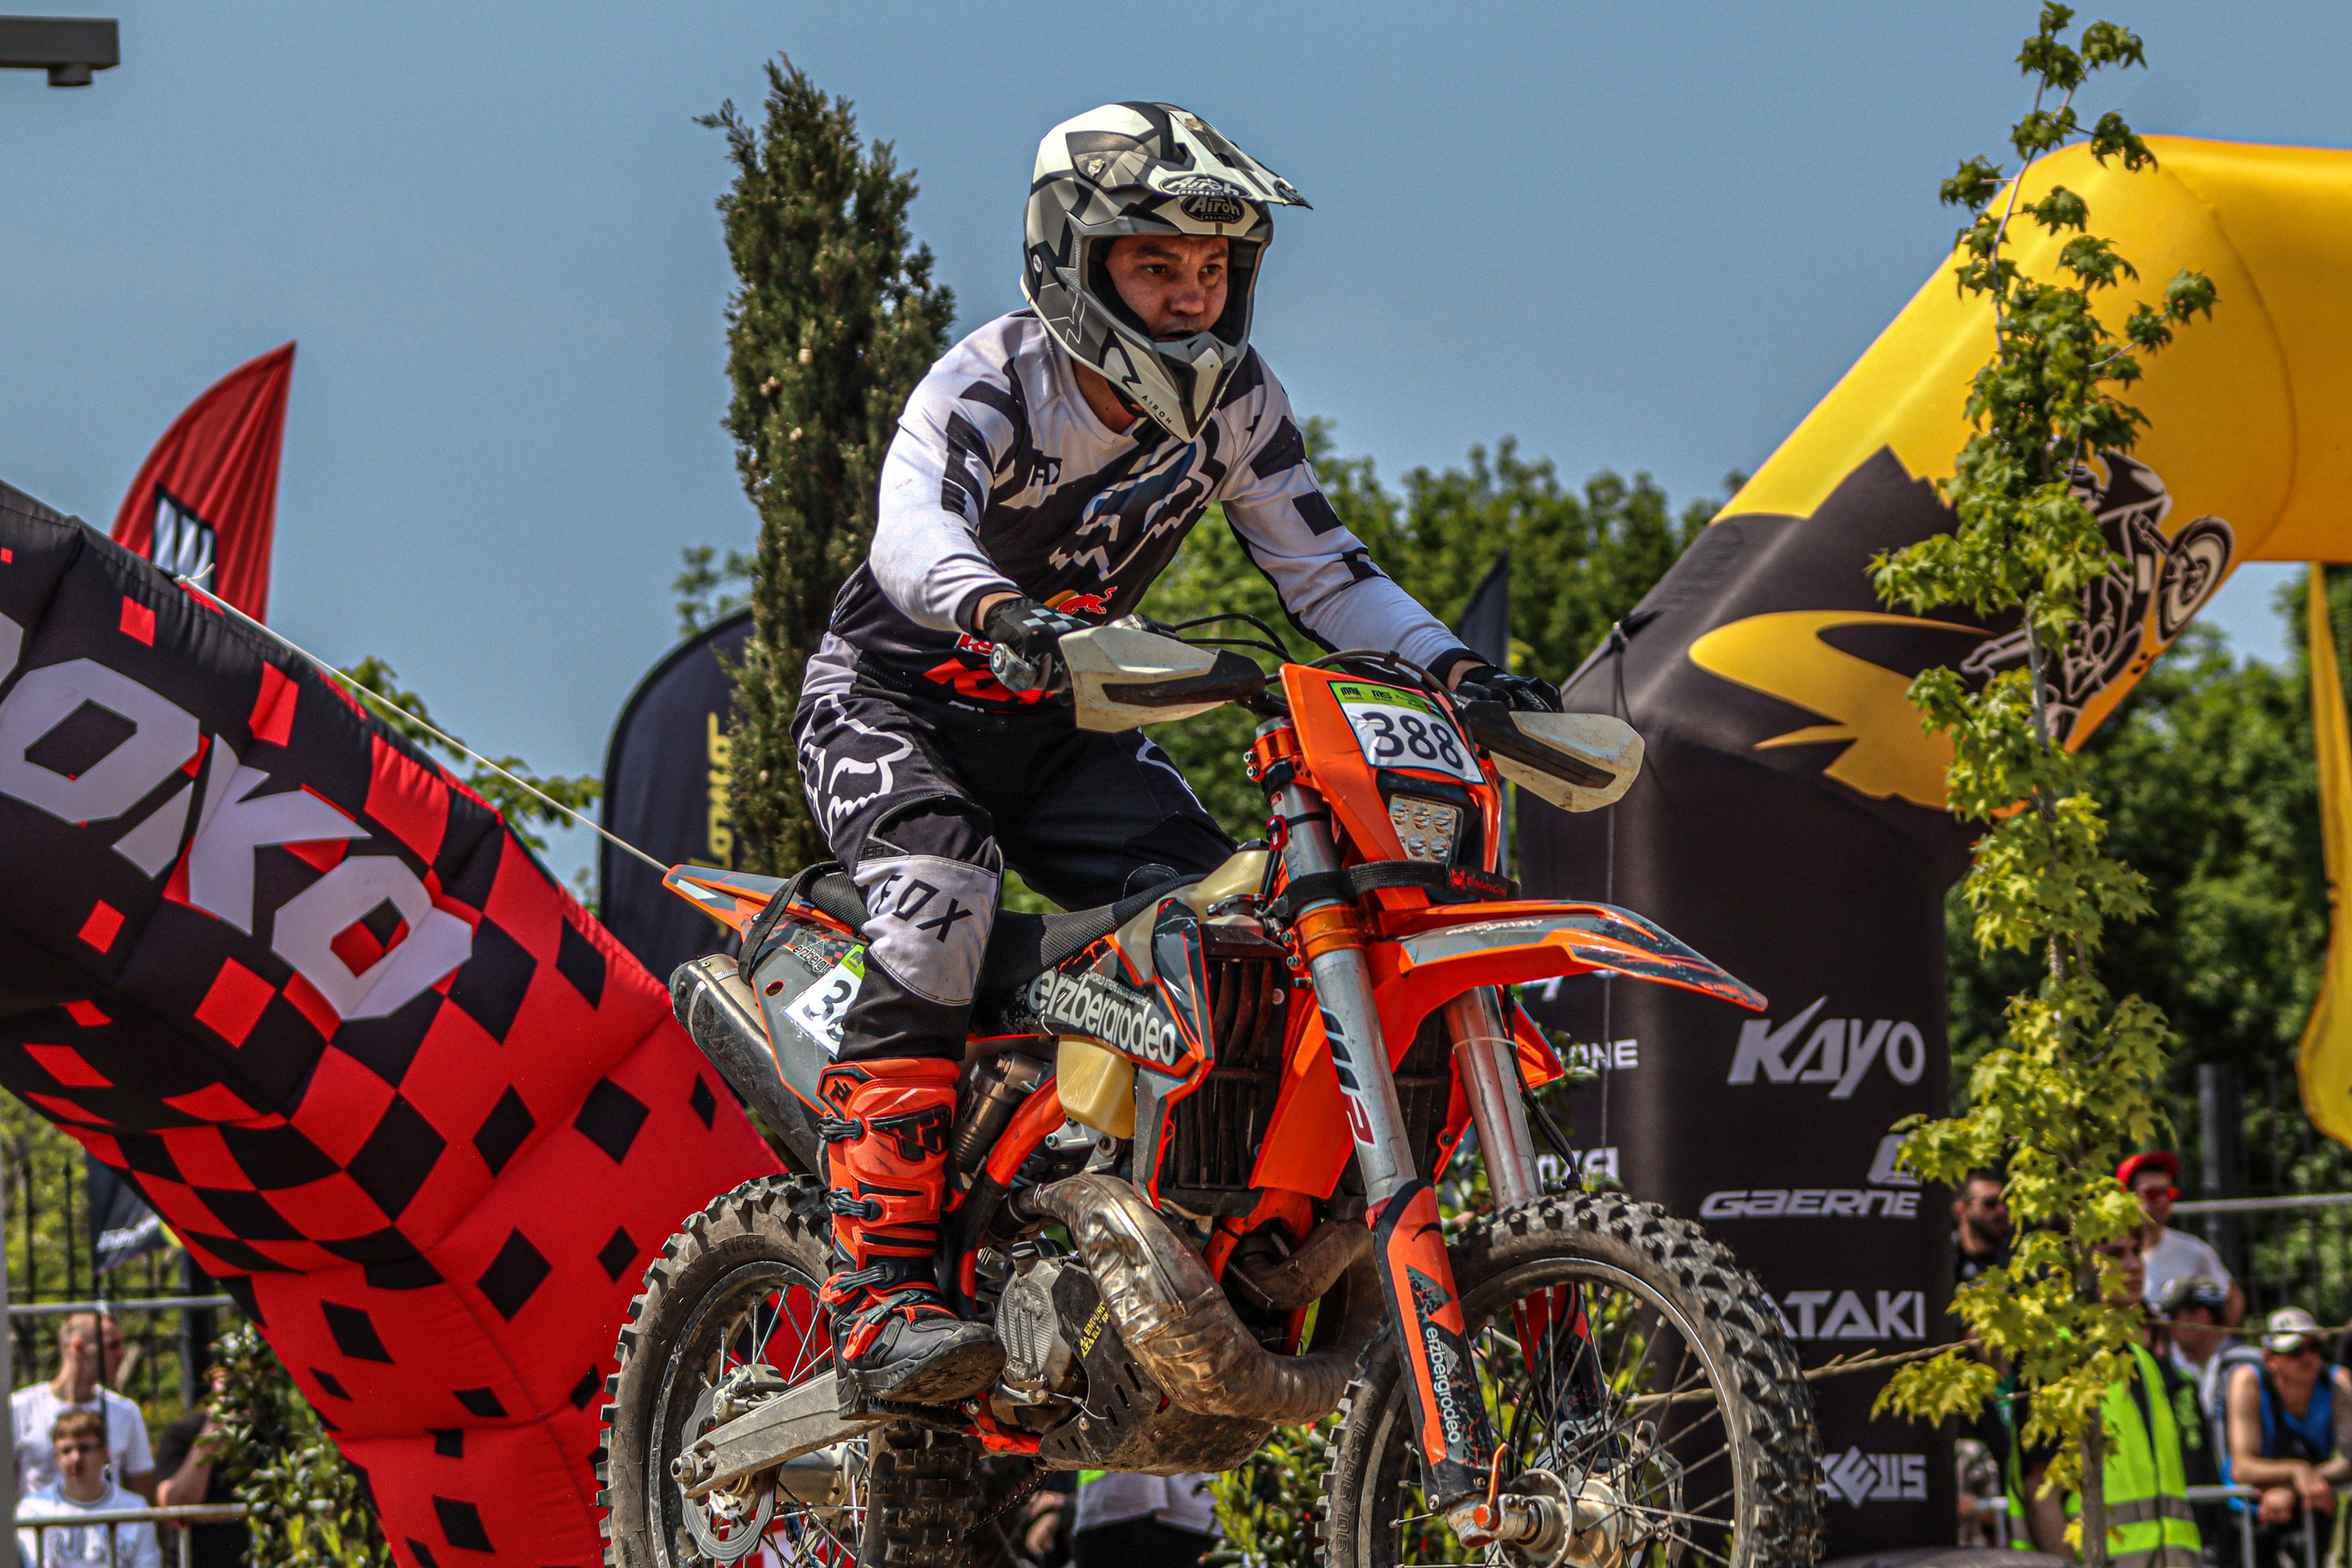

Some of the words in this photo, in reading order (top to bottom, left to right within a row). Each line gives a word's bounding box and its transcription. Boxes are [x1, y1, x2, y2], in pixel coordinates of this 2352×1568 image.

[1165, 175, 1240, 197] Airoh
[1188, 196, 1240, 216] Airoh
[1142, 395, 1172, 423] AIROH
[1361, 711, 1464, 770] 388
[0, 613, 473, 1021] OKO
[874, 874, 973, 943] FOX
[1029, 969, 1176, 1066] erzbergrodeo
[1426, 1327, 1461, 1443] erzbergrodeo
[1336, 1420, 1367, 1553] 90/90-21
